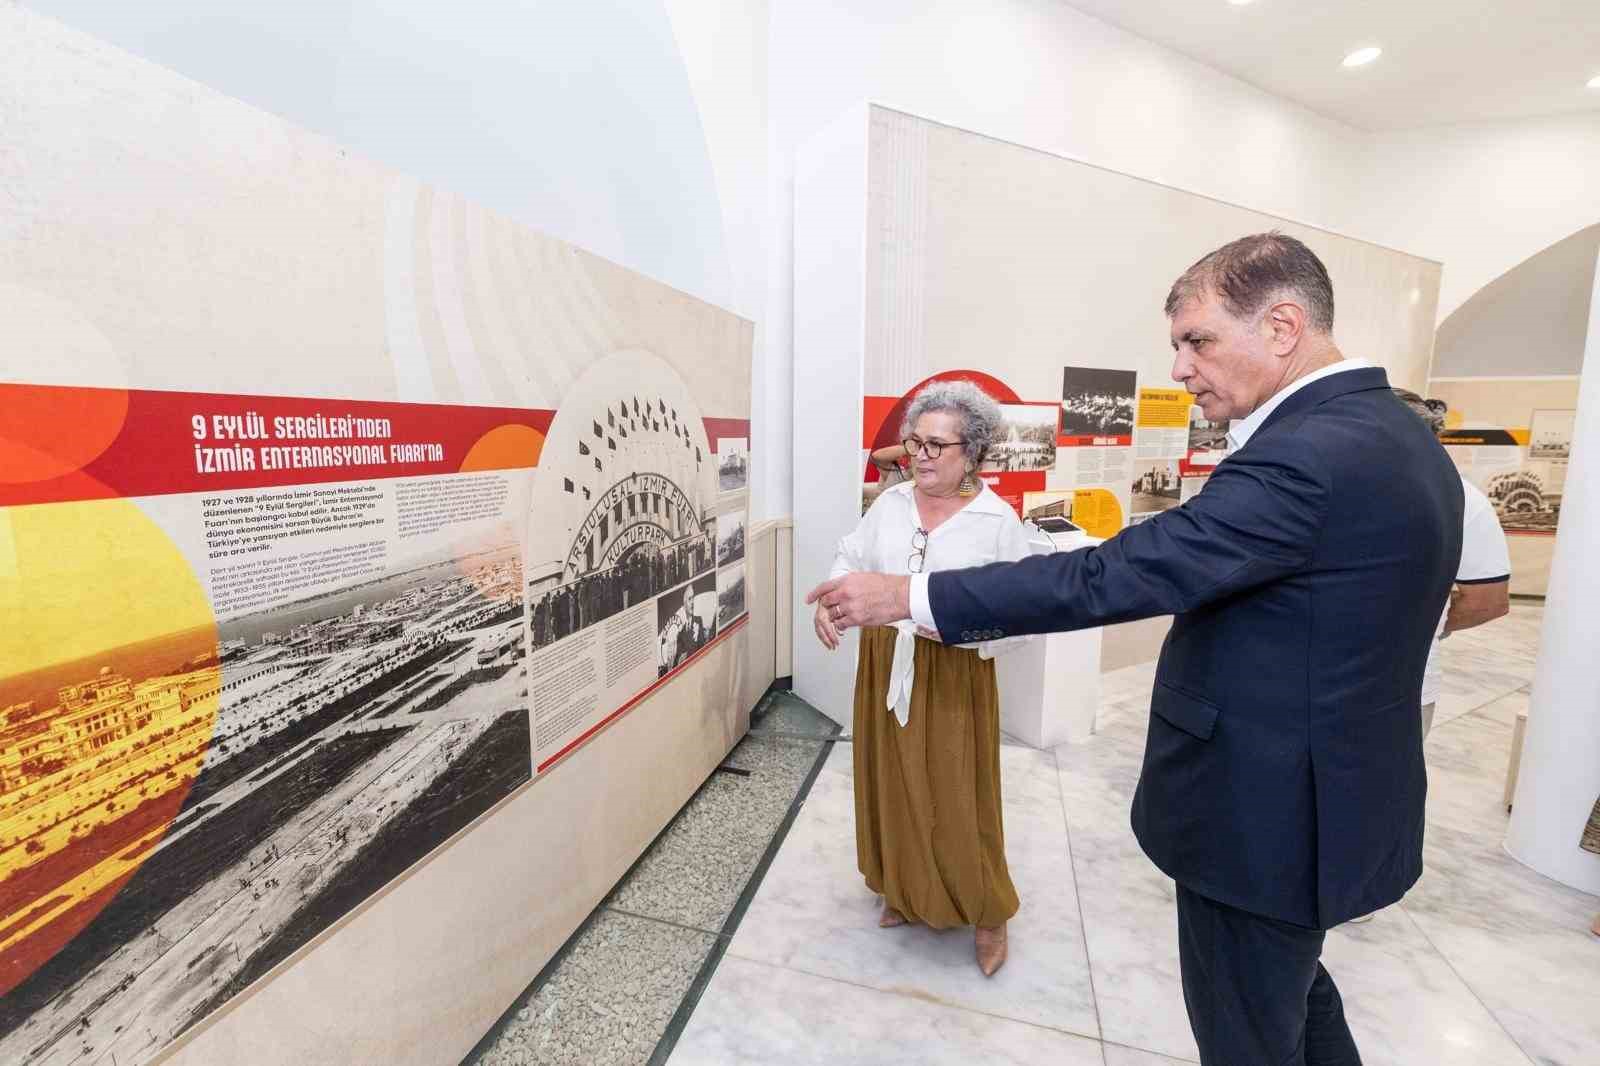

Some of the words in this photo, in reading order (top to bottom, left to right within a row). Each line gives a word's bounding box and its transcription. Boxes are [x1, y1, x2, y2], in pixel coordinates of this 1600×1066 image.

[192, 415, 206, 440] 9
[212, 412, 268, 440] EYLÜL
[274, 413, 392, 439] SERGİLERİ'NDEN
[194, 443, 256, 473] İZMİR
[260, 445, 387, 470] ENTERNASYONAL
[390, 444, 444, 464] FUARI'NA
[202, 498, 220, 507] 1927
[256, 492, 293, 503] yıllarında
[314, 489, 336, 498] Sanayi
[203, 508, 253, 518] düzenlenen
[266, 502, 284, 512] Eylül
[288, 510, 308, 518] kabul
[206, 529, 234, 538] dünya
[208, 550, 228, 559] süre
[230, 547, 246, 556] ara
